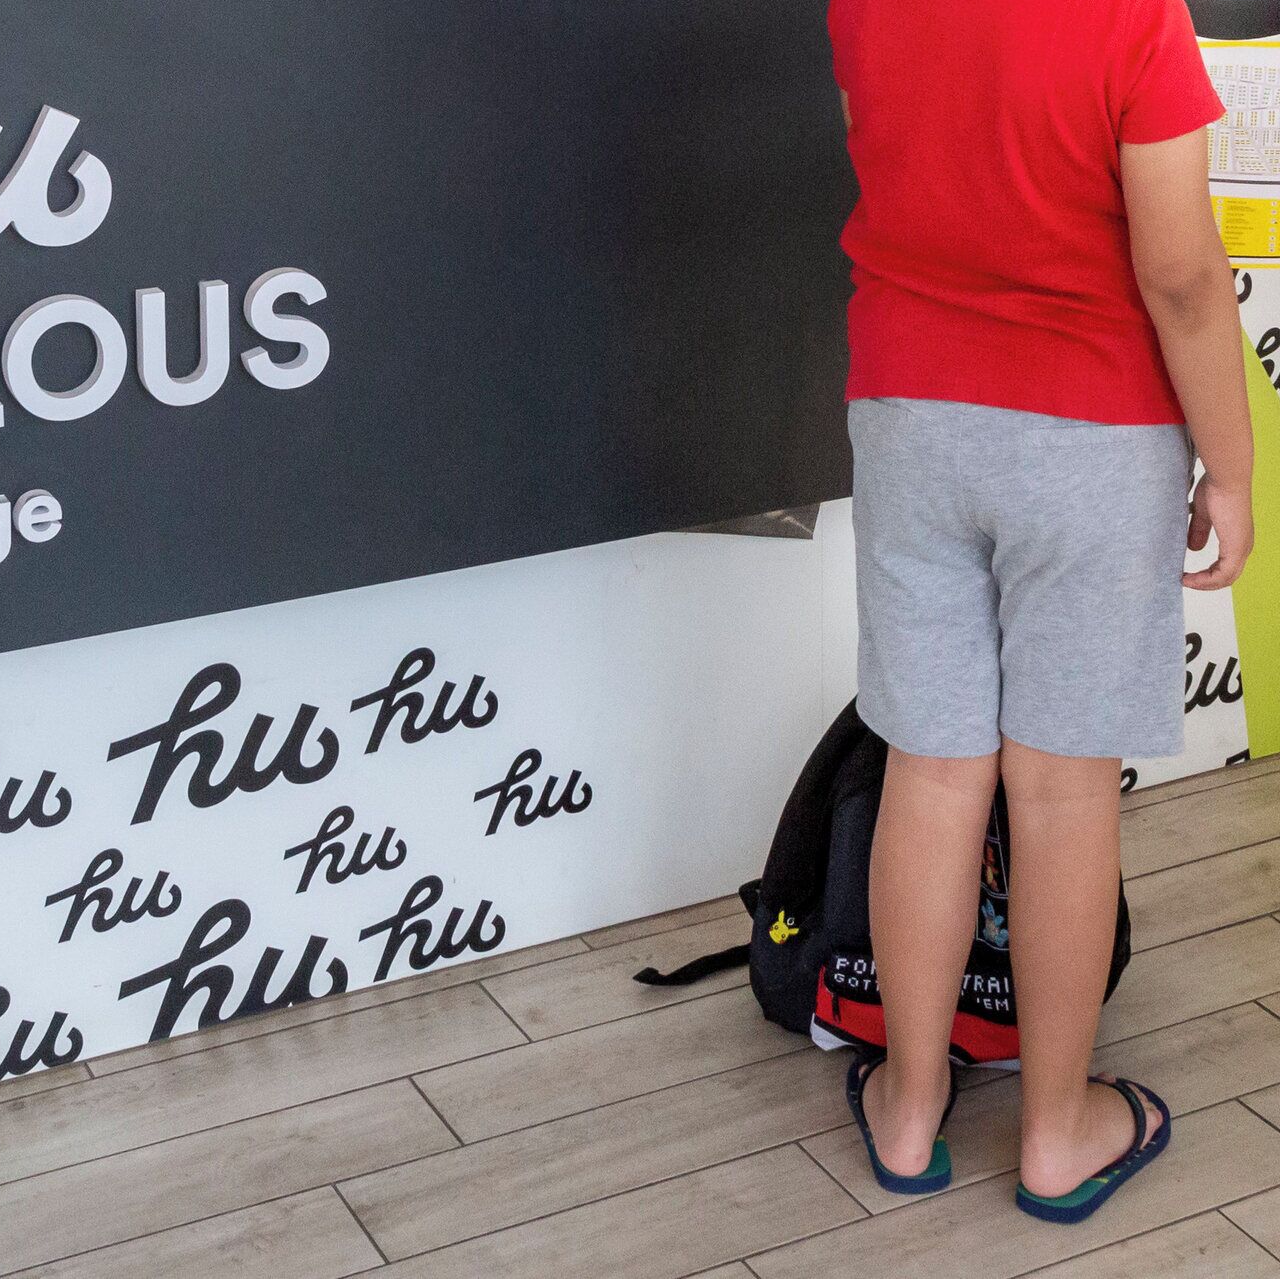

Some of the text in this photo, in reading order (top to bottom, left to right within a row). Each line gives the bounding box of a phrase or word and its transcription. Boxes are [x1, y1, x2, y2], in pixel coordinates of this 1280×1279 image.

[106, 662, 340, 826] hu
[350, 646, 499, 755] hu
[44, 848, 182, 944] hu
[283, 805, 408, 895] hu
[473, 747, 594, 837] hu
[117, 897, 349, 1044] hu
[358, 874, 506, 983] hu
